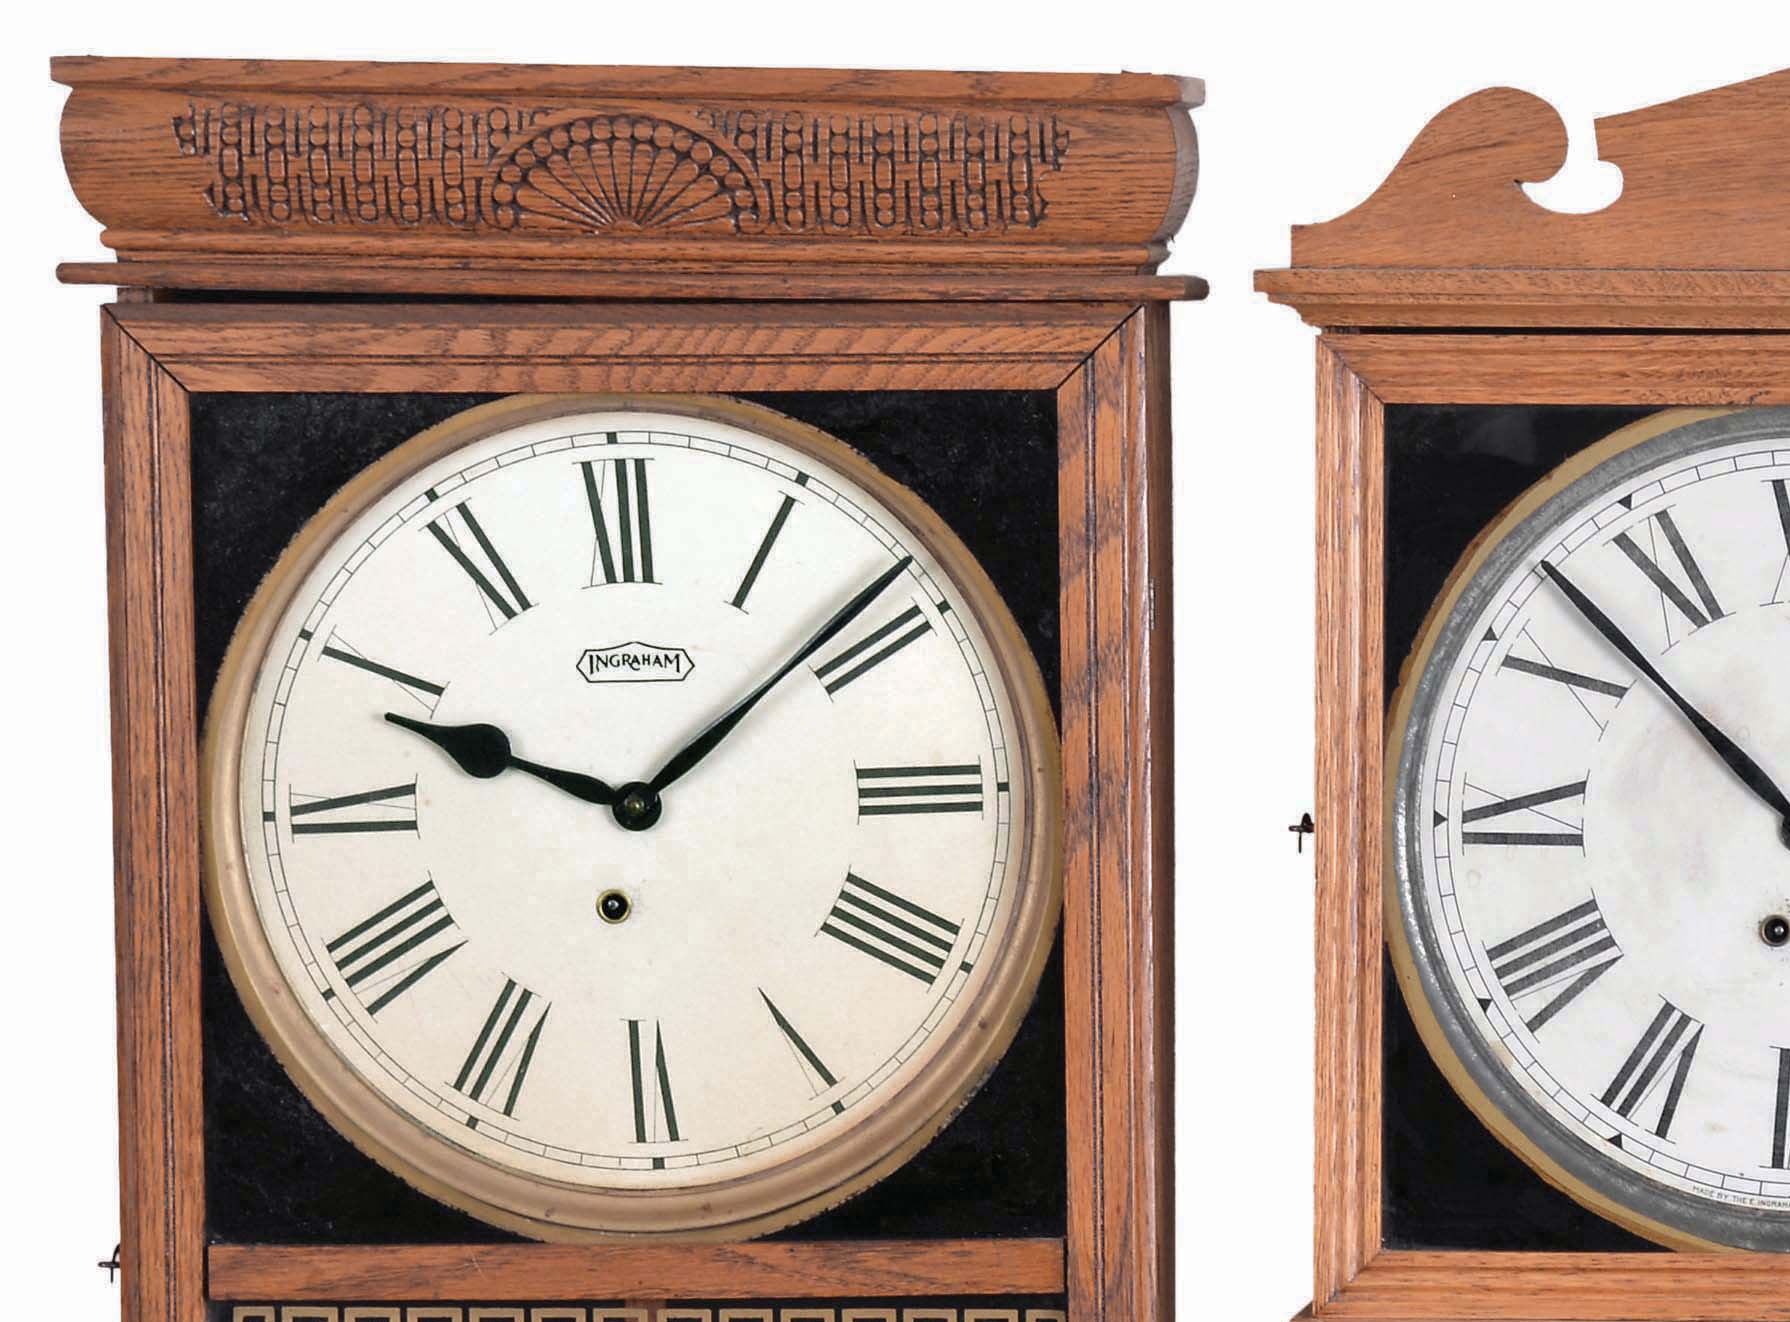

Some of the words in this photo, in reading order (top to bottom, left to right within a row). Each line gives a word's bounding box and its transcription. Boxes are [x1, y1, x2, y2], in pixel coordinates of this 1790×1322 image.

[419, 495, 539, 635] XI
[572, 457, 663, 589] XII
[723, 491, 805, 615] I
[1603, 509, 1735, 654] XI
[321, 626, 451, 718] X
[589, 653, 680, 675] INGRAHAM
[808, 597, 939, 703] II
[1496, 620, 1639, 741] X
[289, 774, 421, 844] IX
[853, 760, 985, 825] III
[1462, 769, 1592, 856] IX
[323, 869, 470, 1024] VIII
[814, 865, 963, 993] IIII
[1482, 889, 1624, 1043] VIII
[445, 972, 553, 1121] VII
[620, 1017, 688, 1144] VI
[757, 986, 845, 1102] V
[1592, 994, 1705, 1146] VII
